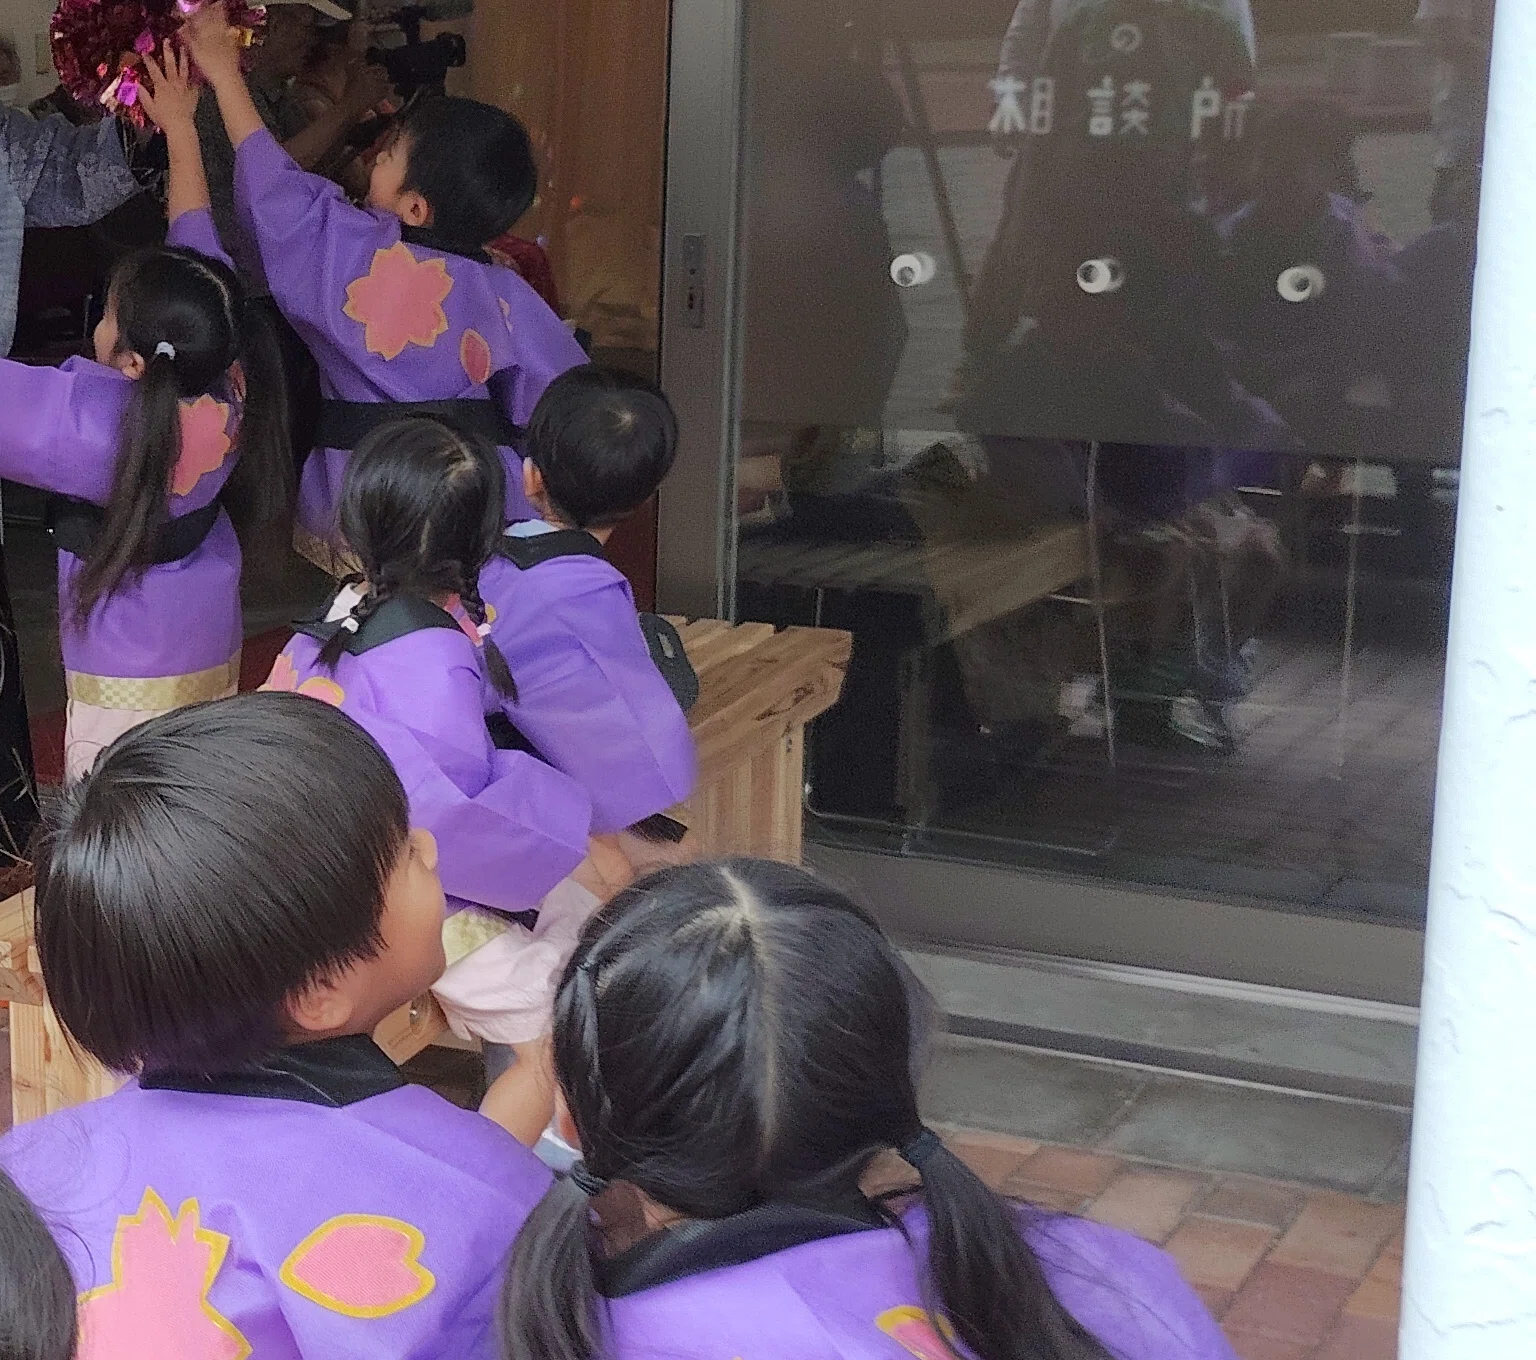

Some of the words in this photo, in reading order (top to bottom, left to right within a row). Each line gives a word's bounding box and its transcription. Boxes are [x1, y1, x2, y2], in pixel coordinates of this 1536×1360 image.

[1110, 22, 1143, 54] の
[986, 74, 1256, 140] 相談所
